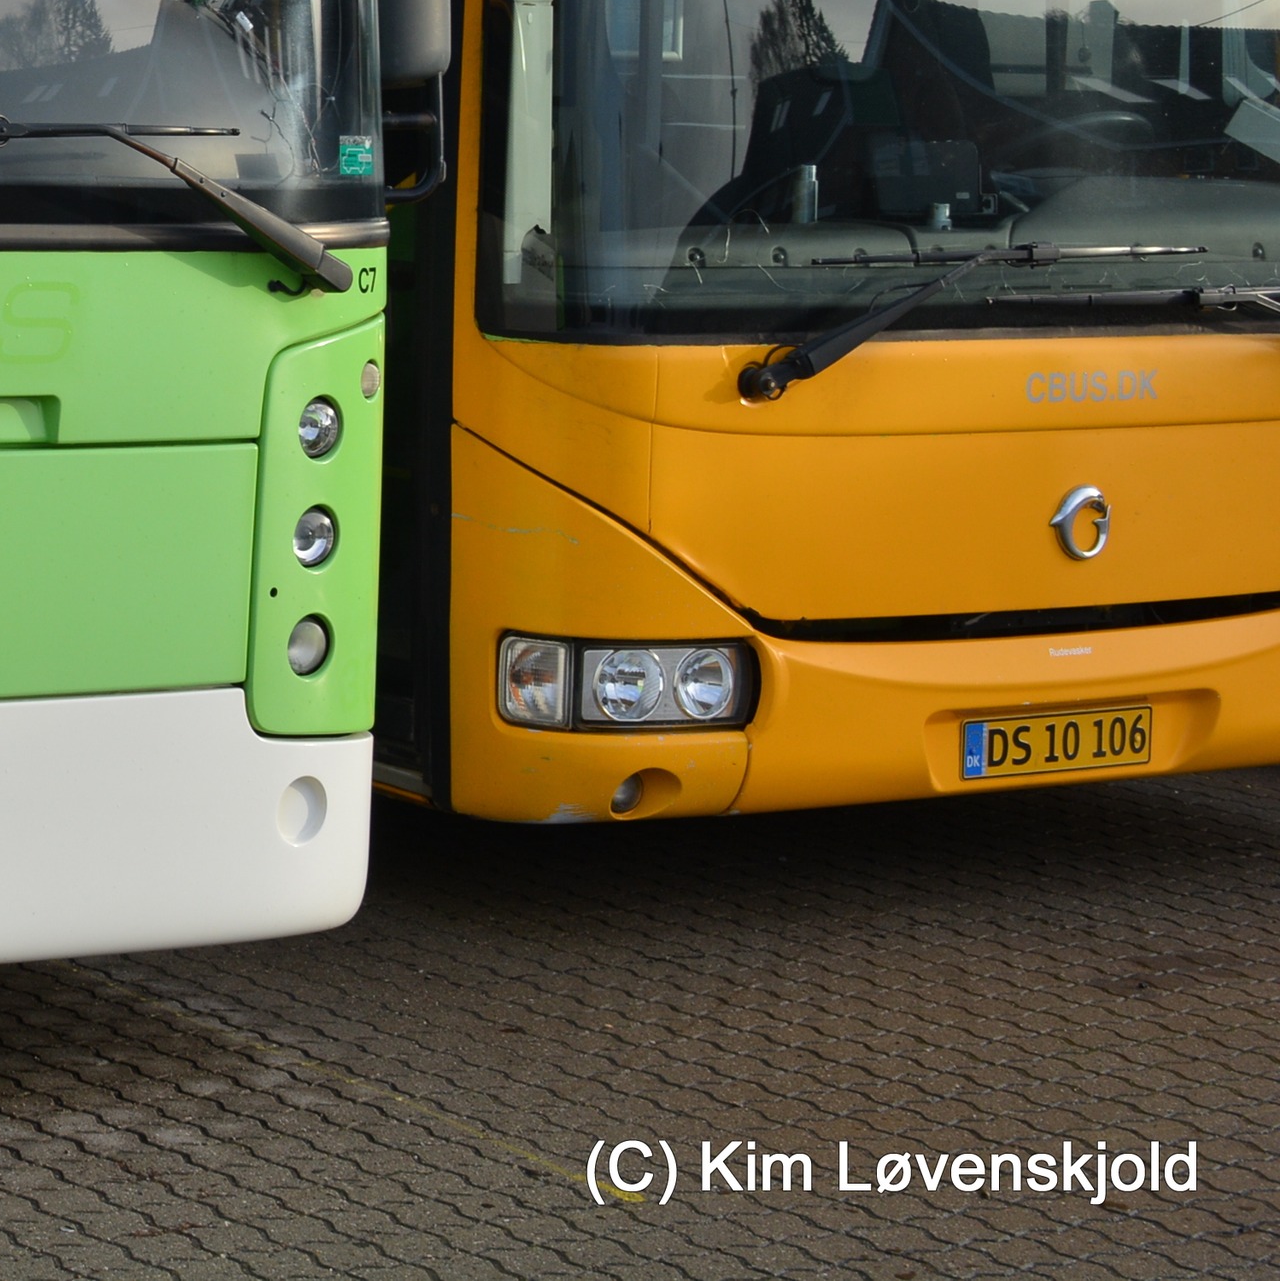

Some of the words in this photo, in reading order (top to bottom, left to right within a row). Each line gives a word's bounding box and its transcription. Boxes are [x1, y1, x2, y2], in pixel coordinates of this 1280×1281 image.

[358, 267, 377, 294] C7
[1026, 369, 1159, 404] CBUS.DK
[966, 755, 980, 768] DK
[987, 725, 1032, 768] DS
[1044, 720, 1080, 763] 10
[1092, 713, 1147, 758] 106
